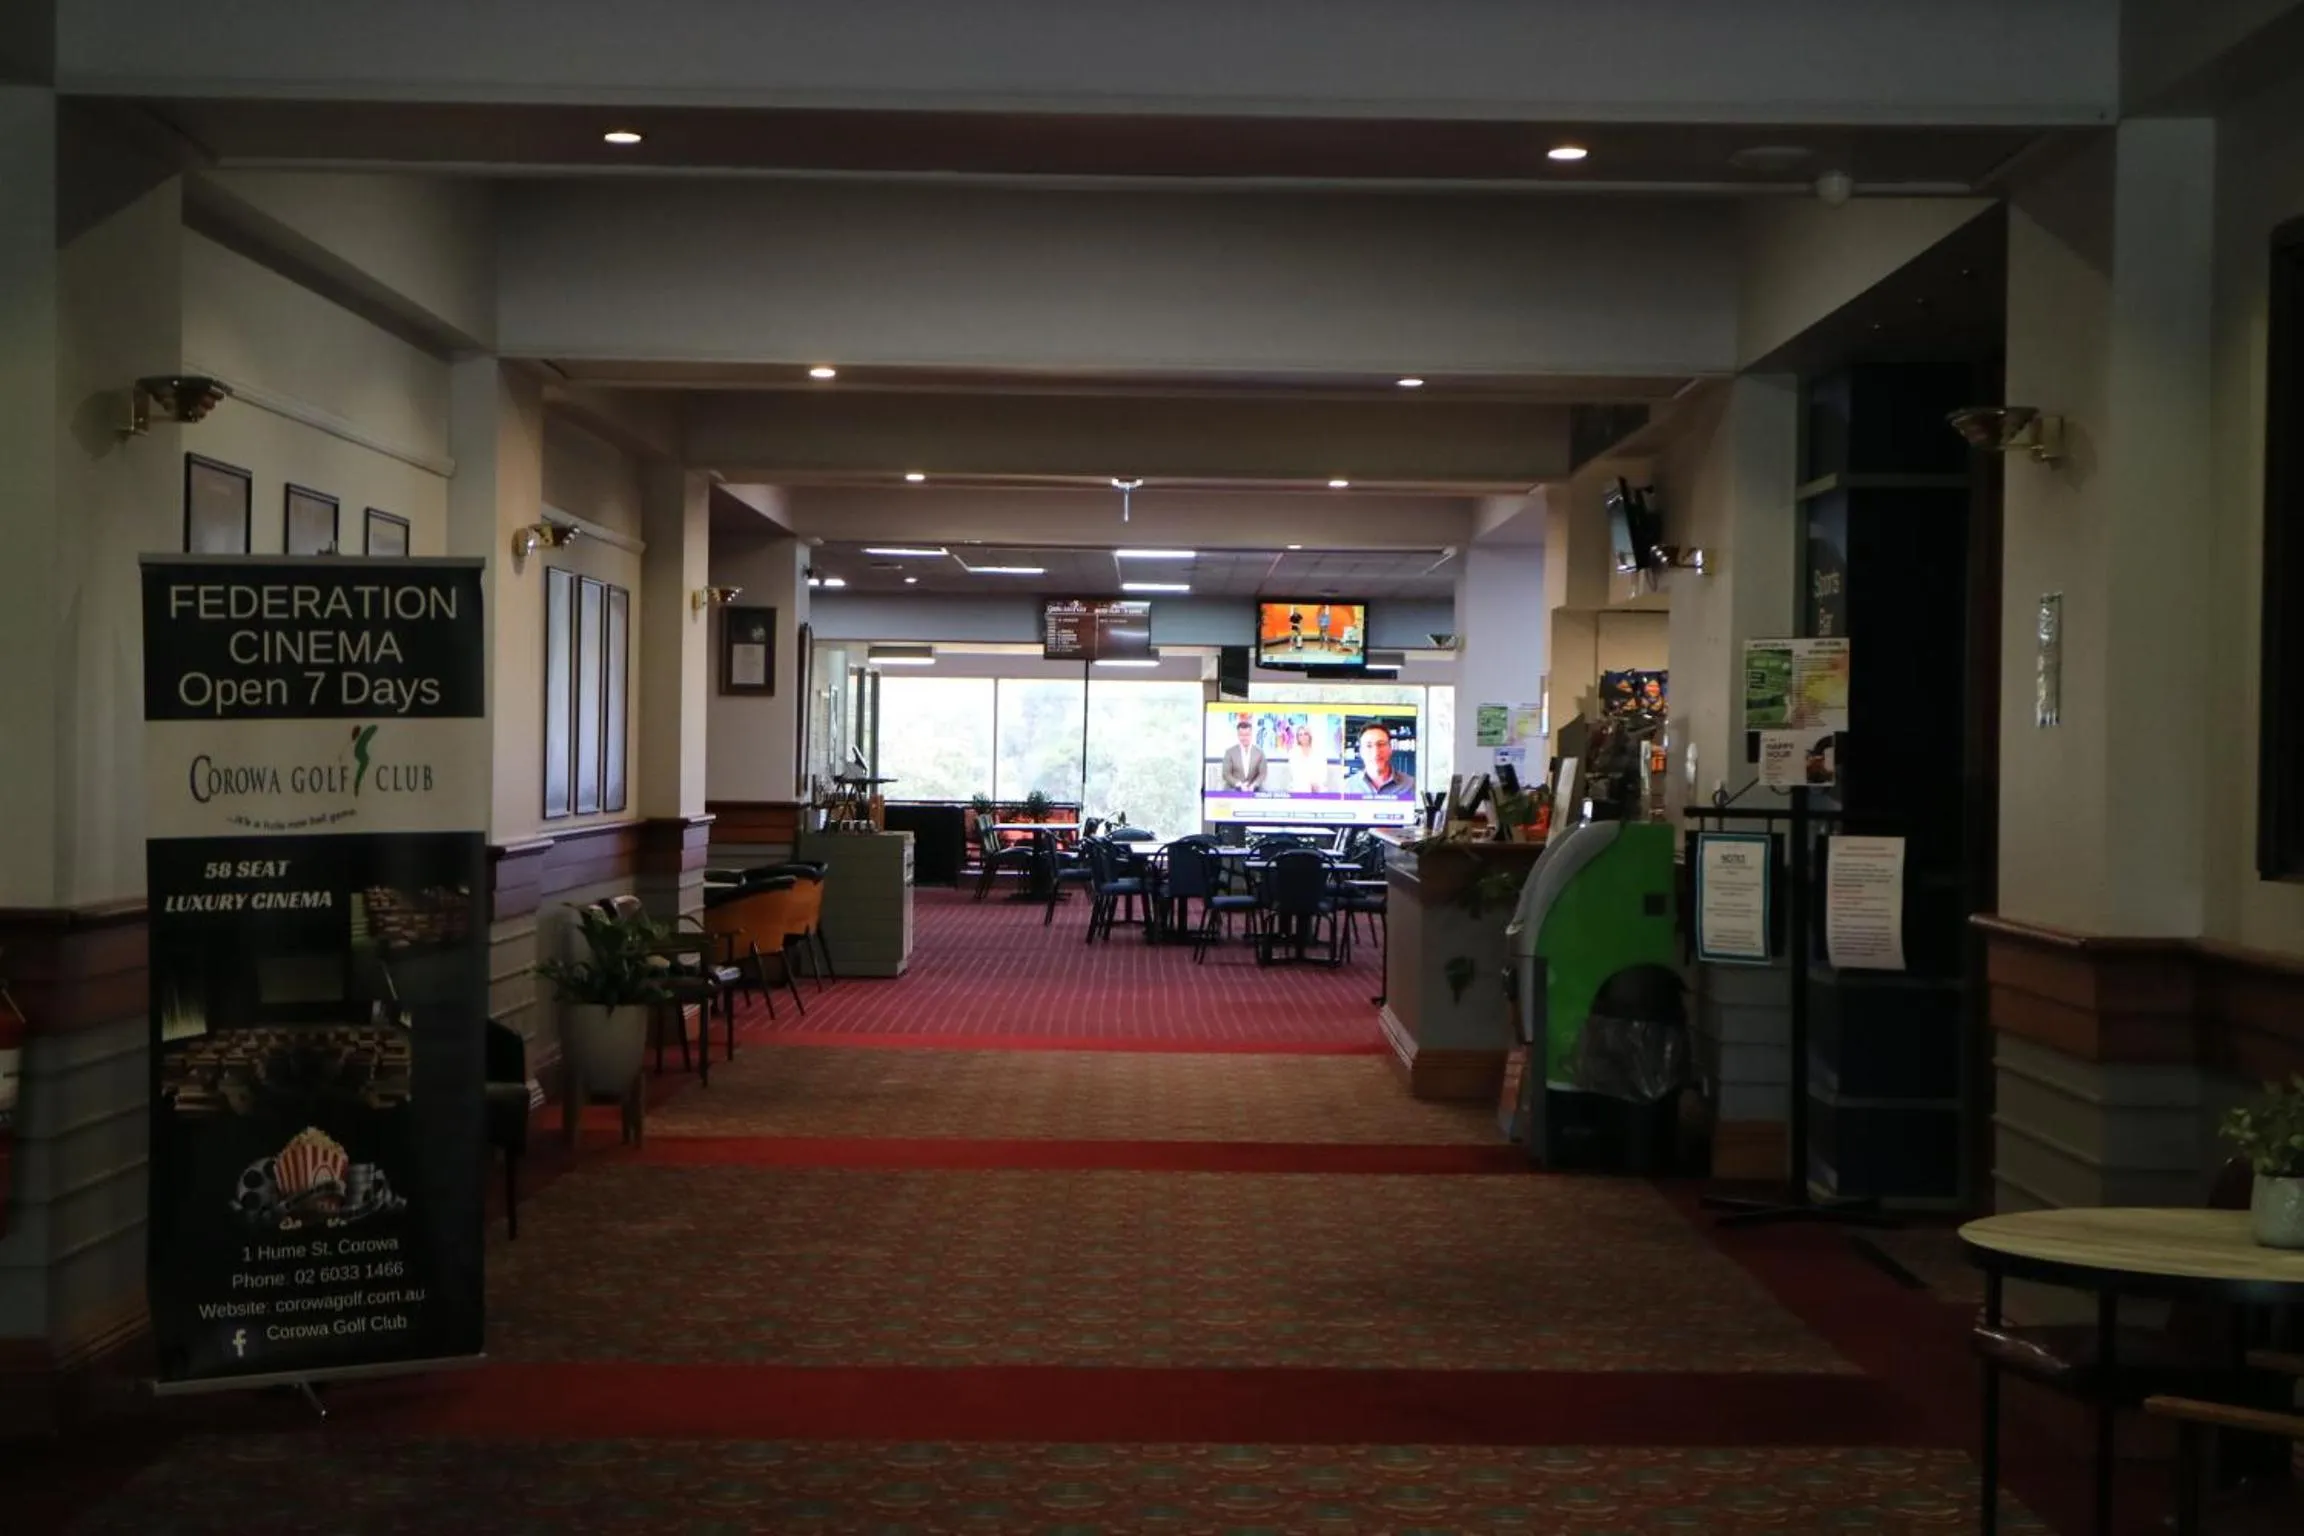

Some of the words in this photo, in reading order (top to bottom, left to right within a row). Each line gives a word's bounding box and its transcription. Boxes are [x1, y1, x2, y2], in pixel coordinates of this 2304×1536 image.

[169, 585, 458, 620] FEDERATION
[229, 630, 404, 664] CINEMA
[178, 671, 289, 716] Open
[303, 671, 325, 705] 7
[342, 671, 441, 714] Days
[190, 754, 282, 804] COROWA
[290, 764, 349, 795] GOLF
[375, 764, 434, 792] CLUB
[204, 861, 232, 880] 58
[235, 859, 292, 879] SEAT
[163, 891, 250, 914] LUXURY
[250, 889, 333, 910] CINEMA
[242, 1246, 253, 1263] 1
[256, 1243, 307, 1262] Hume
[337, 1236, 400, 1256] Corowa
[294, 1267, 316, 1285] 02
[320, 1264, 360, 1283] 6033
[365, 1260, 405, 1280] 1466
[275, 1286, 426, 1313] corowagolf.com.au
[231, 1328, 248, 1359] f
[265, 1323, 330, 1342] Corowa
[333, 1316, 368, 1335] Golf
[370, 1313, 408, 1332] Club
